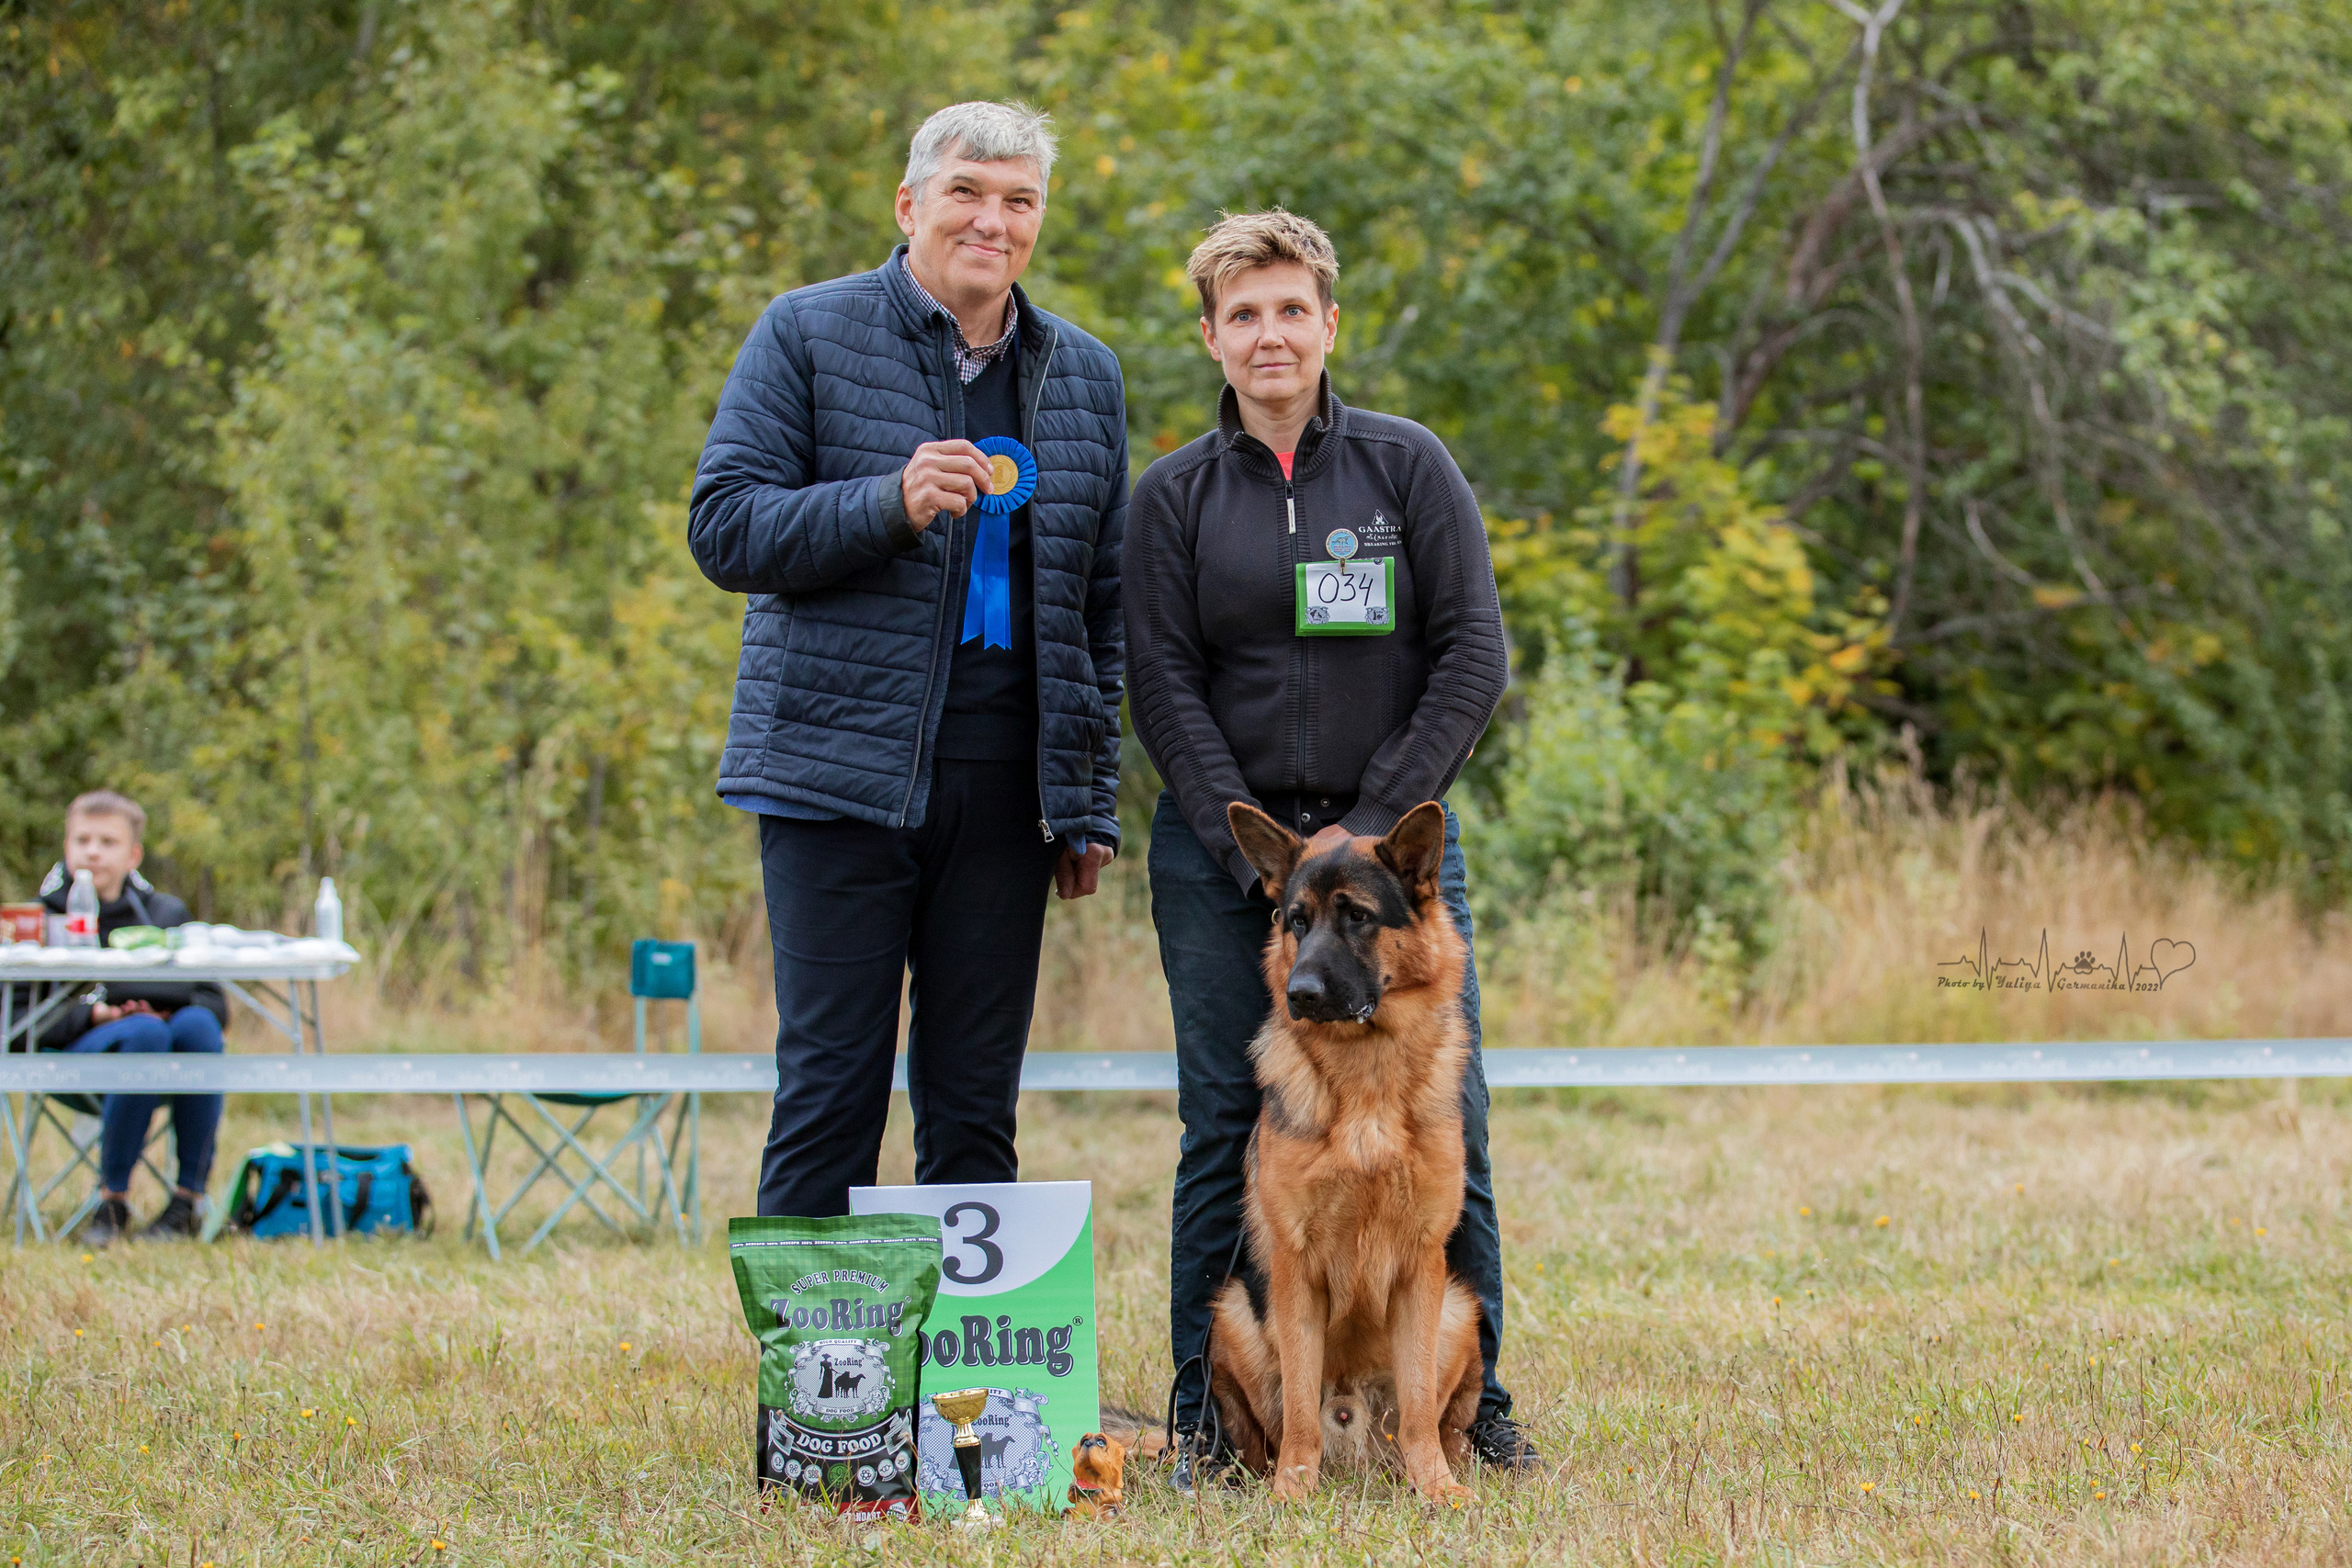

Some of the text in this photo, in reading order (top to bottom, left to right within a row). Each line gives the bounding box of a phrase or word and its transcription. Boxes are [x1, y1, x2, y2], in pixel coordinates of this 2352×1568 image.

[1317, 572, 1374, 606] 034
[942, 1201, 1004, 1284] 3
[791, 1269, 890, 1295] SUPER PREMIUM
[796, 1432, 882, 1454] DOG FOOD
